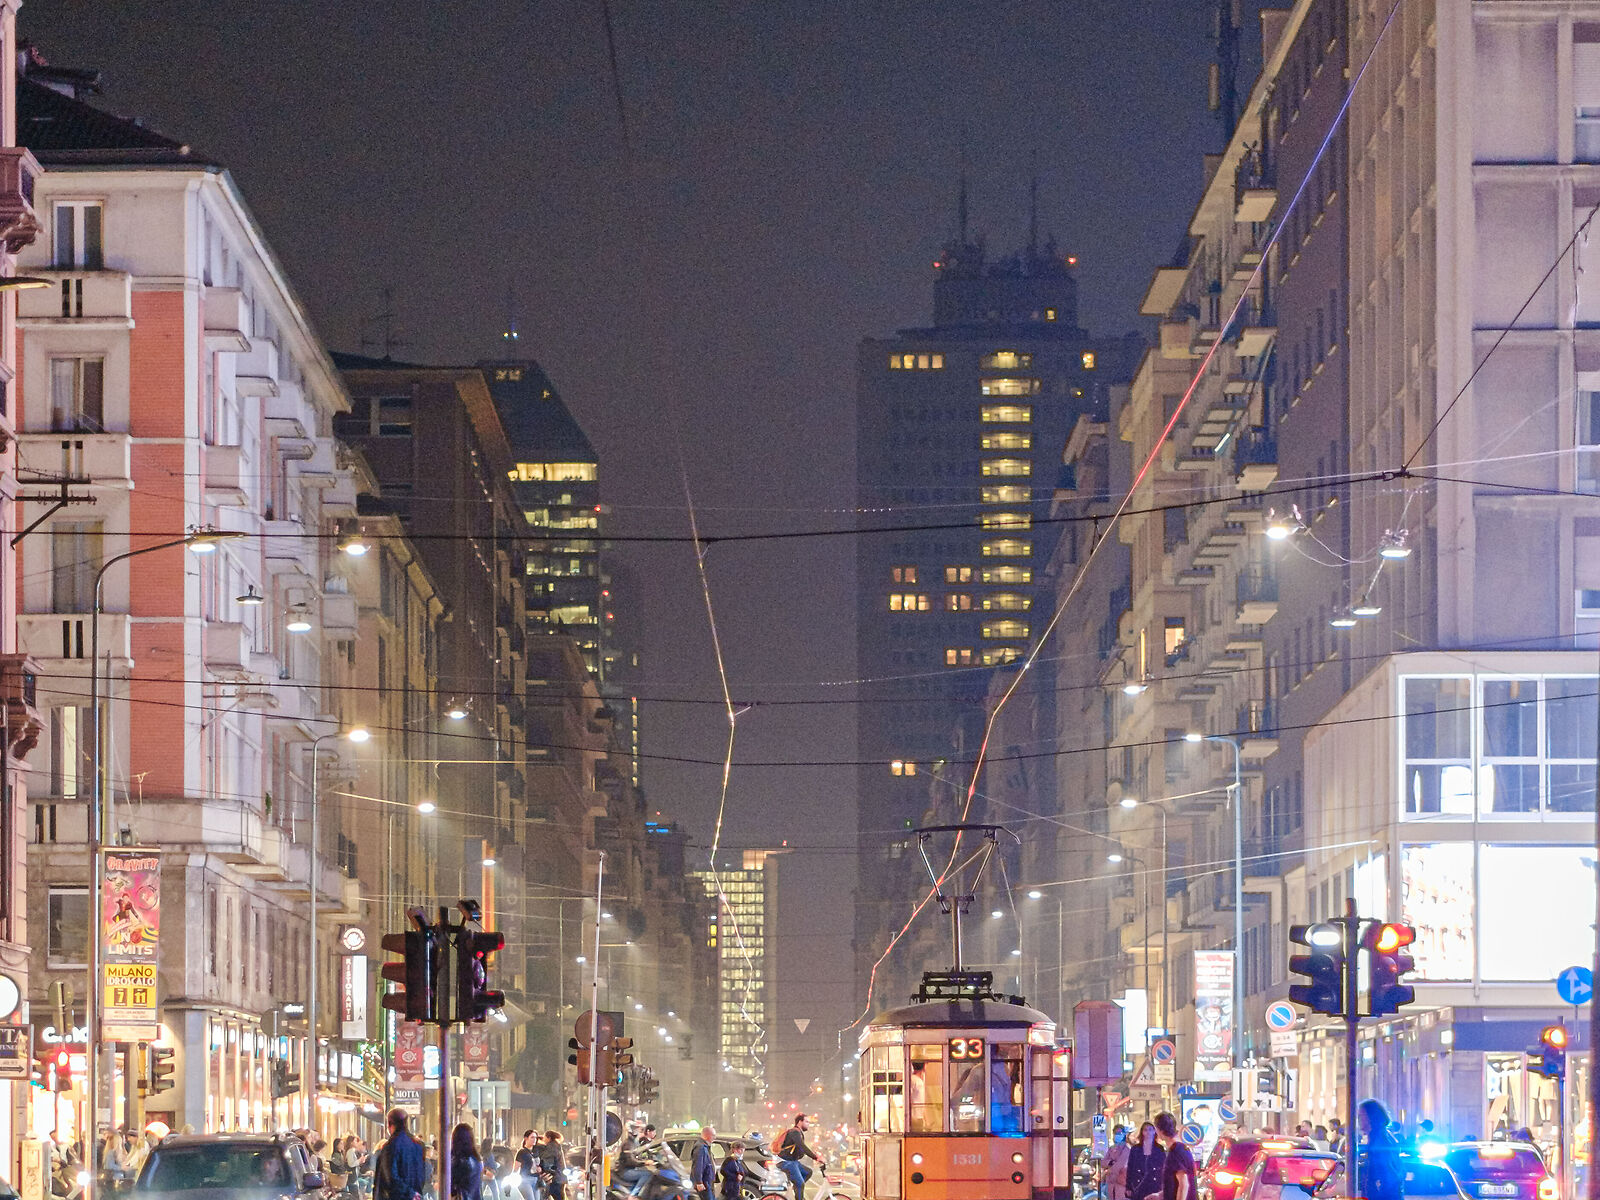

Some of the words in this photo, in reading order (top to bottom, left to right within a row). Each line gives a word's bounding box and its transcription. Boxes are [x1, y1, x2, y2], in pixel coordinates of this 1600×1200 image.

[106, 856, 159, 871] GRAVITY
[507, 876, 518, 955] HOTEL
[108, 945, 153, 956] LIMITS
[108, 966, 153, 977] MILANO
[106, 977, 155, 986] IDROSCALO
[117, 991, 125, 1003] 7
[134, 992, 146, 1004] 11
[951, 1038, 983, 1059] 33
[395, 1090, 420, 1098] MOTTA
[953, 1154, 982, 1165] 1531
